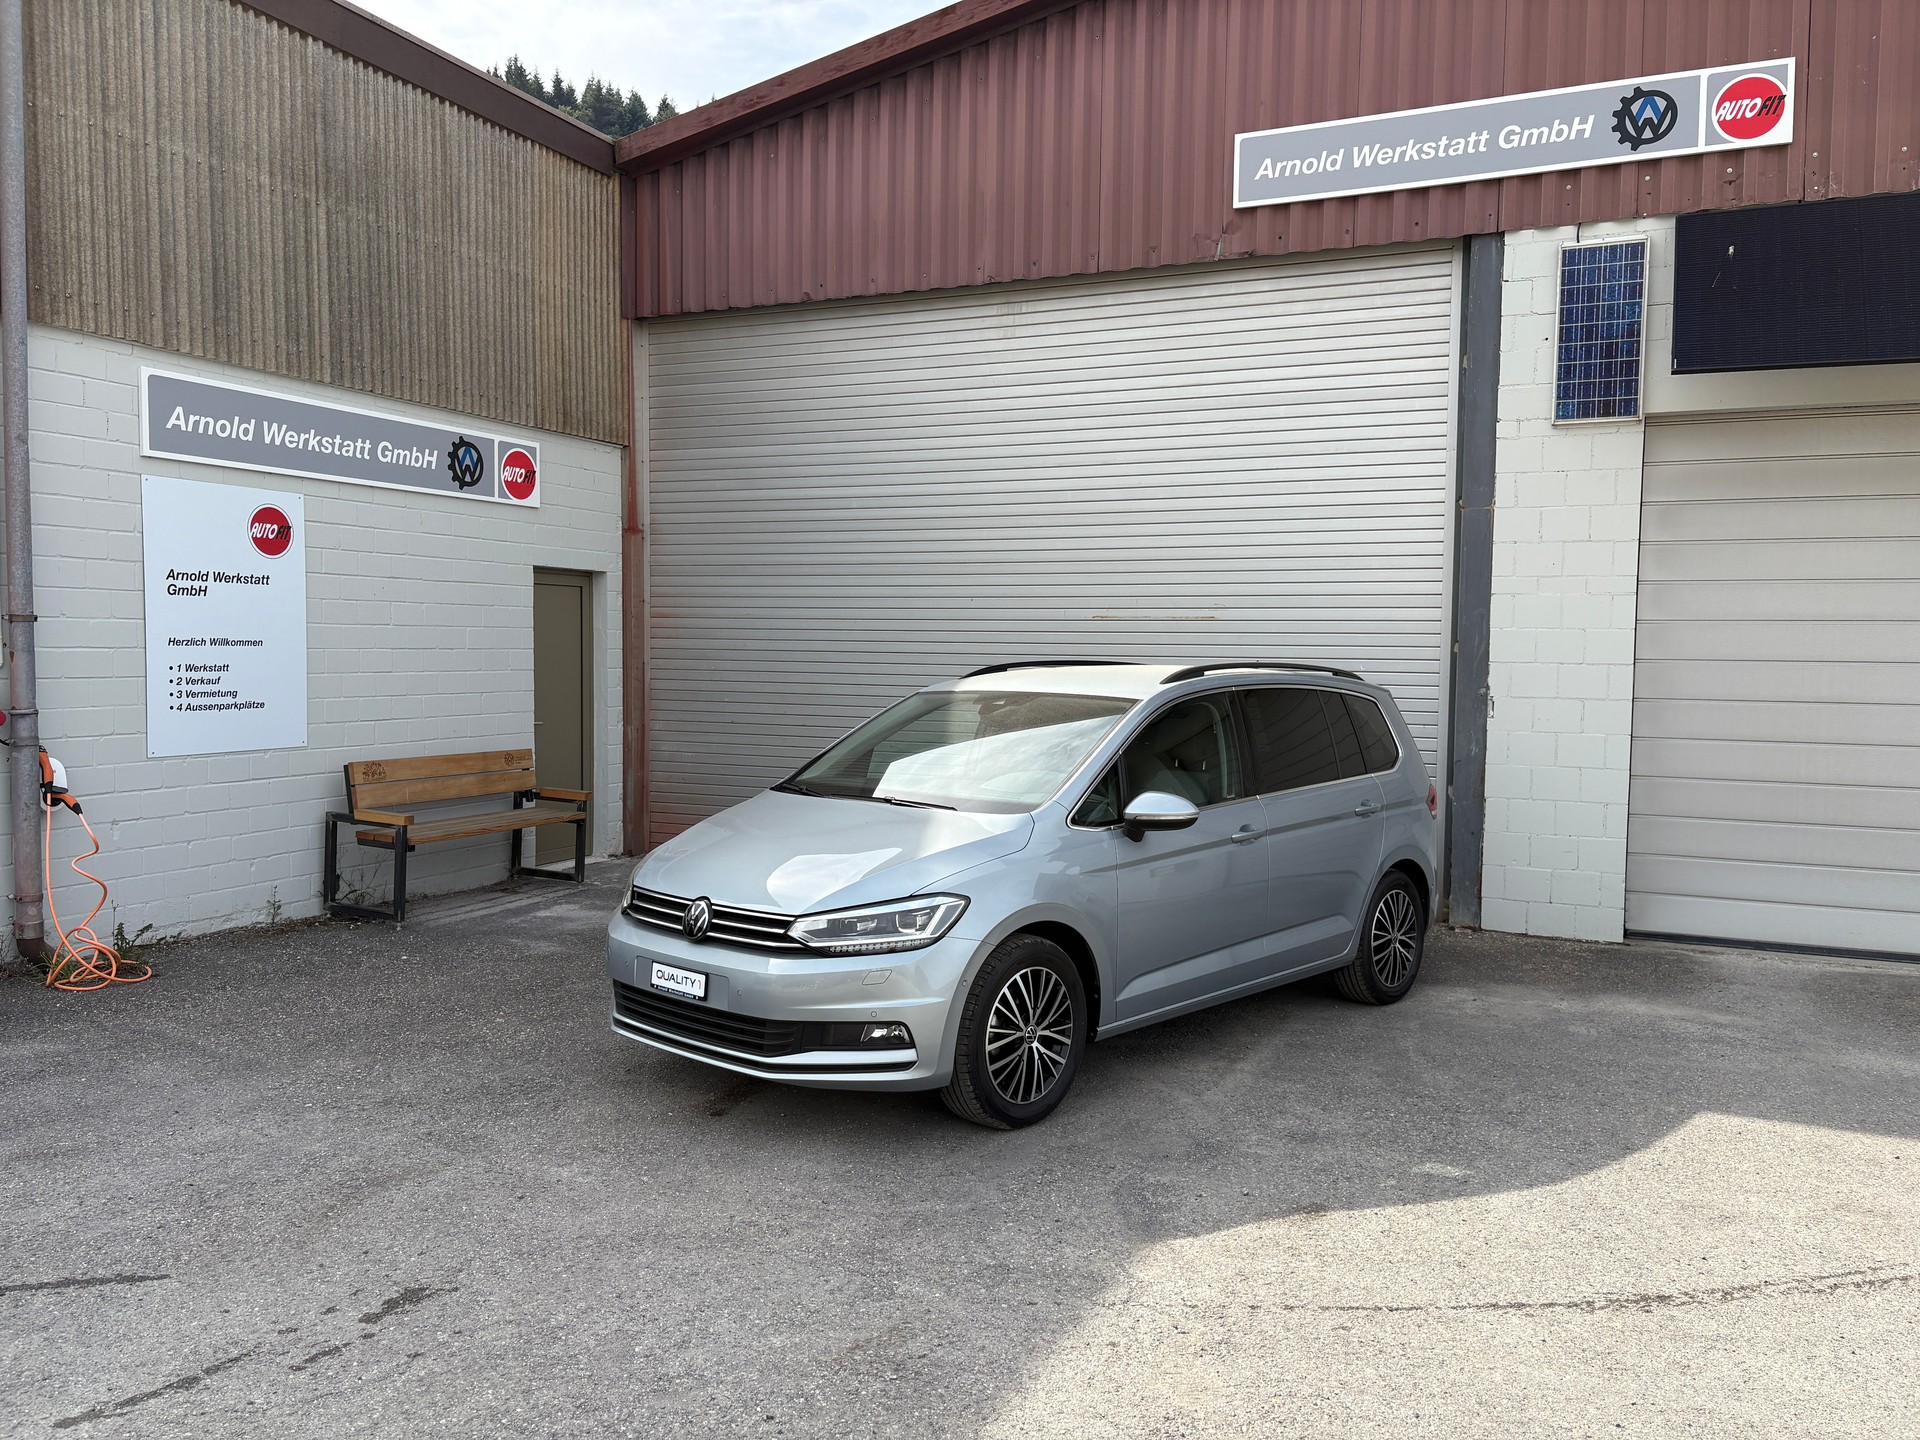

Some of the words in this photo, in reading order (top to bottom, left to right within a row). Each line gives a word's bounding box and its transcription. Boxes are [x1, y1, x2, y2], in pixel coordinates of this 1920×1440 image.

[1254, 148, 1343, 181] Arnold
[1352, 130, 1490, 169] Werkstatt
[1498, 114, 1596, 151] GmbH
[166, 406, 255, 442] Arnold
[263, 421, 371, 460] Werkstatt
[377, 441, 438, 470] GmbH
[166, 568, 209, 583] Arnold
[213, 571, 270, 586] Werkstatt
[167, 583, 208, 597] GmbH
[168, 637, 207, 648] Herzlich
[209, 637, 263, 648] Willkommen
[176, 663, 182, 673] 1
[185, 663, 230, 673] Werkstatt
[176, 676, 183, 686] 2
[185, 676, 221, 686] Verkauf
[176, 689, 183, 699] 3
[185, 688, 238, 700] Vermietung
[176, 702, 183, 712] 4
[185, 700, 266, 713] Aussenparkplätze
[656, 969, 696, 988] QUALITY
